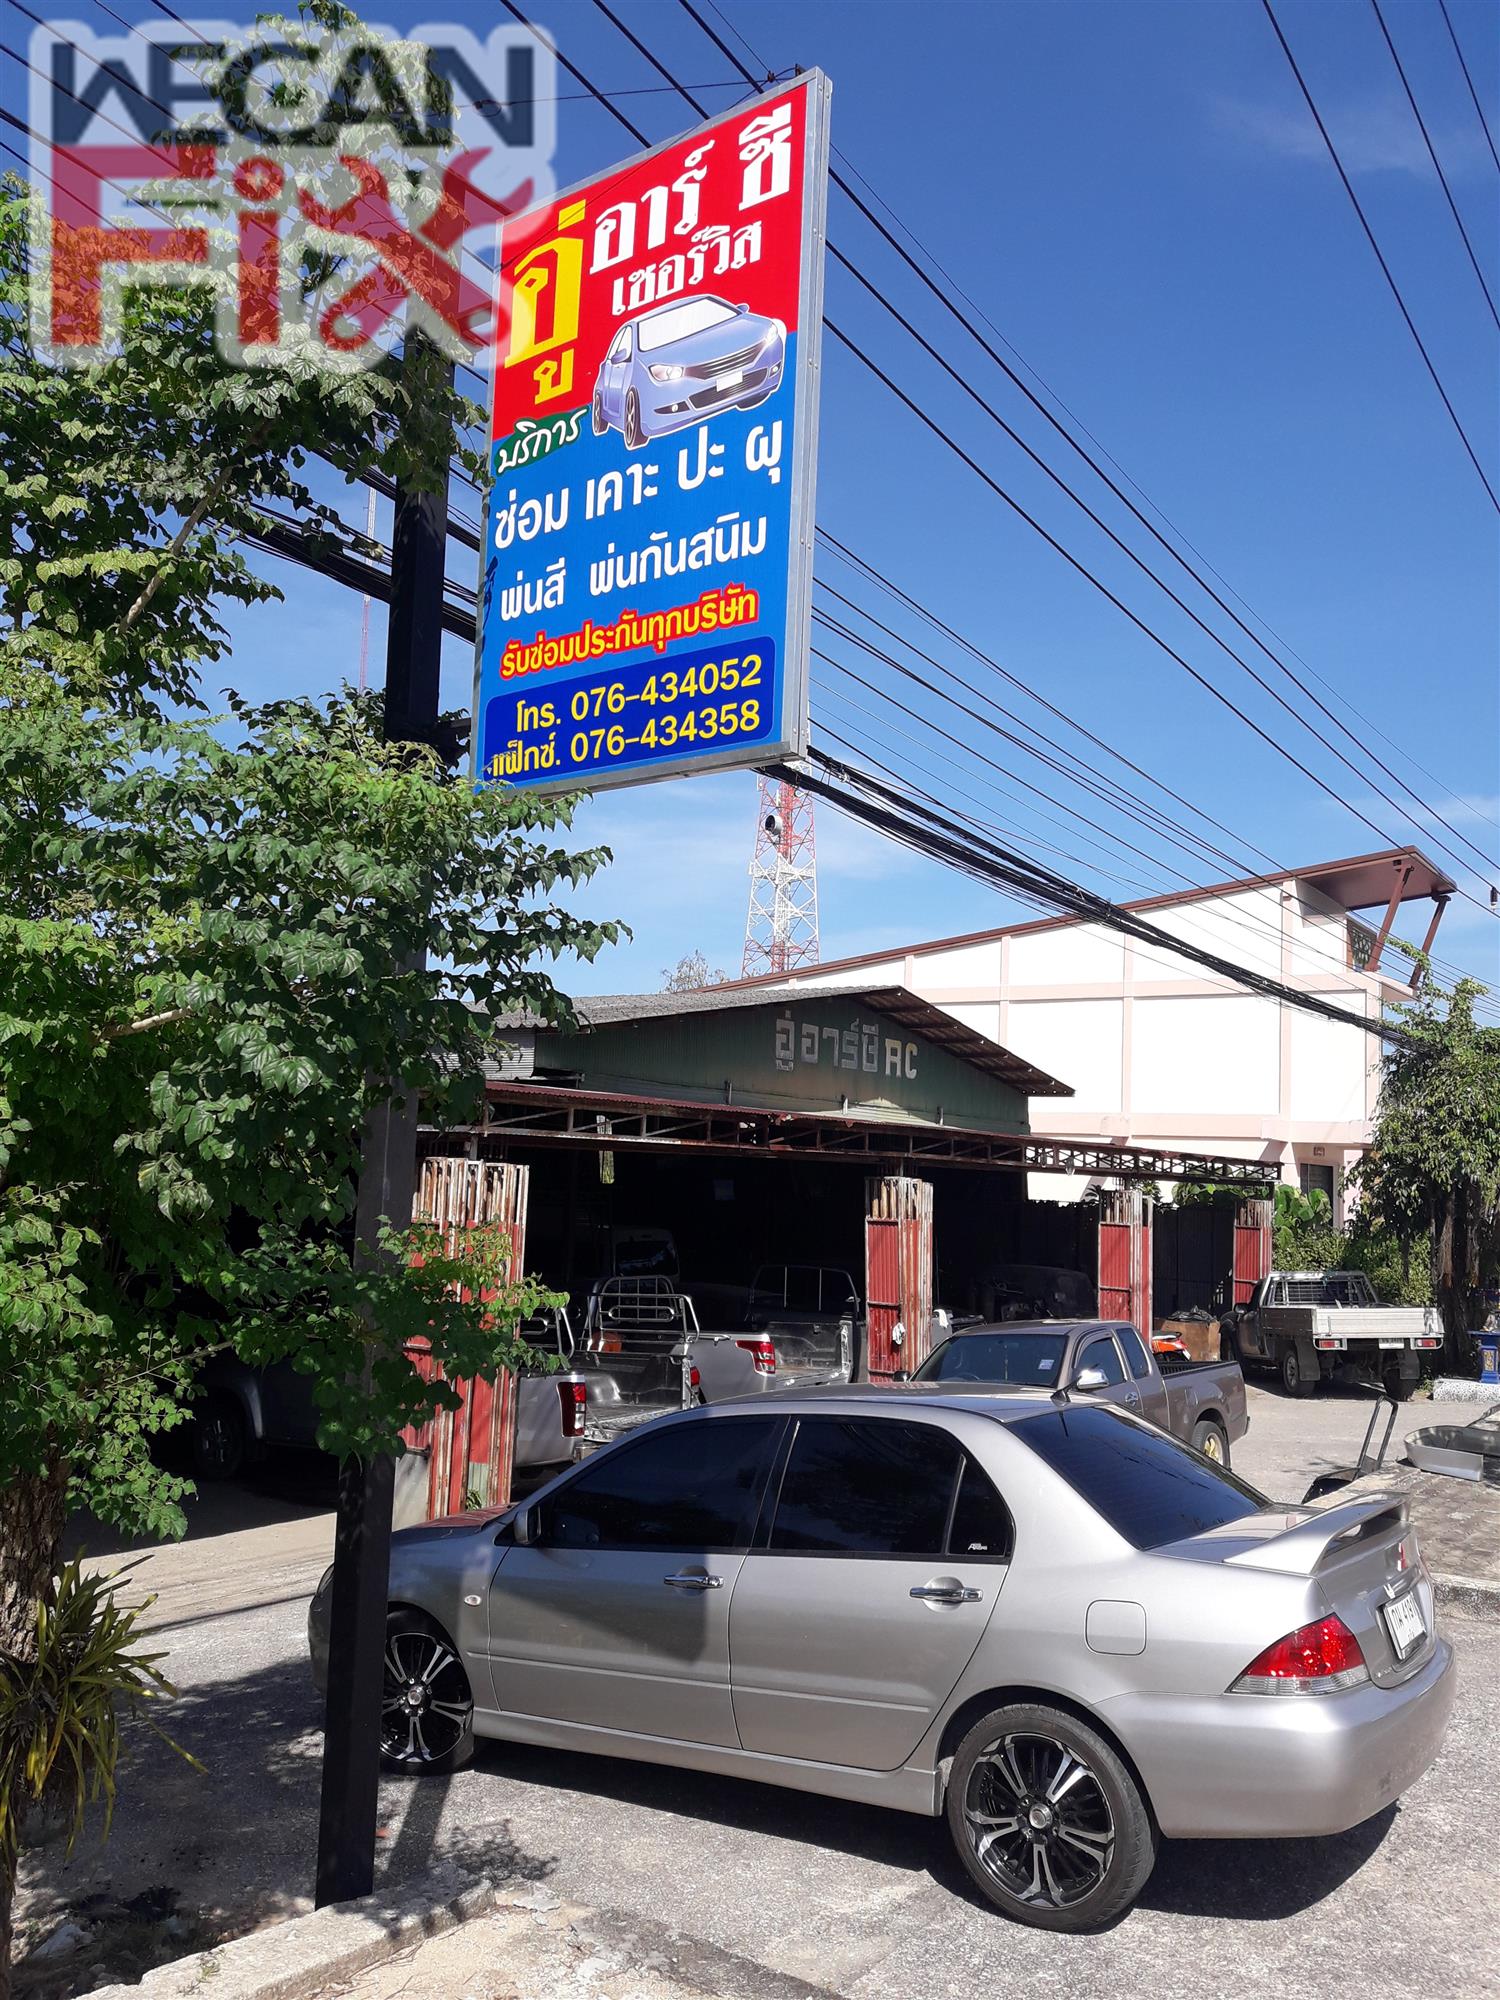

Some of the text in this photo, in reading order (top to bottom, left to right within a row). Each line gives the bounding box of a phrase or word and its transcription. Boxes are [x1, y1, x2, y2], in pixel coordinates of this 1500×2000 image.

[611, 220, 763, 316] เซอร์วิส
[494, 420, 783, 549] ซ่อม เคาะ ปะ ผุ
[498, 408, 588, 473] บริการ
[501, 511, 768, 621] พ่นสี พ่นกันสนิม
[501, 586, 757, 677] รับซ่อมประกันทุกบริษัท
[516, 653, 763, 732] โทร. 076-434052
[569, 699, 761, 764] 076-434358
